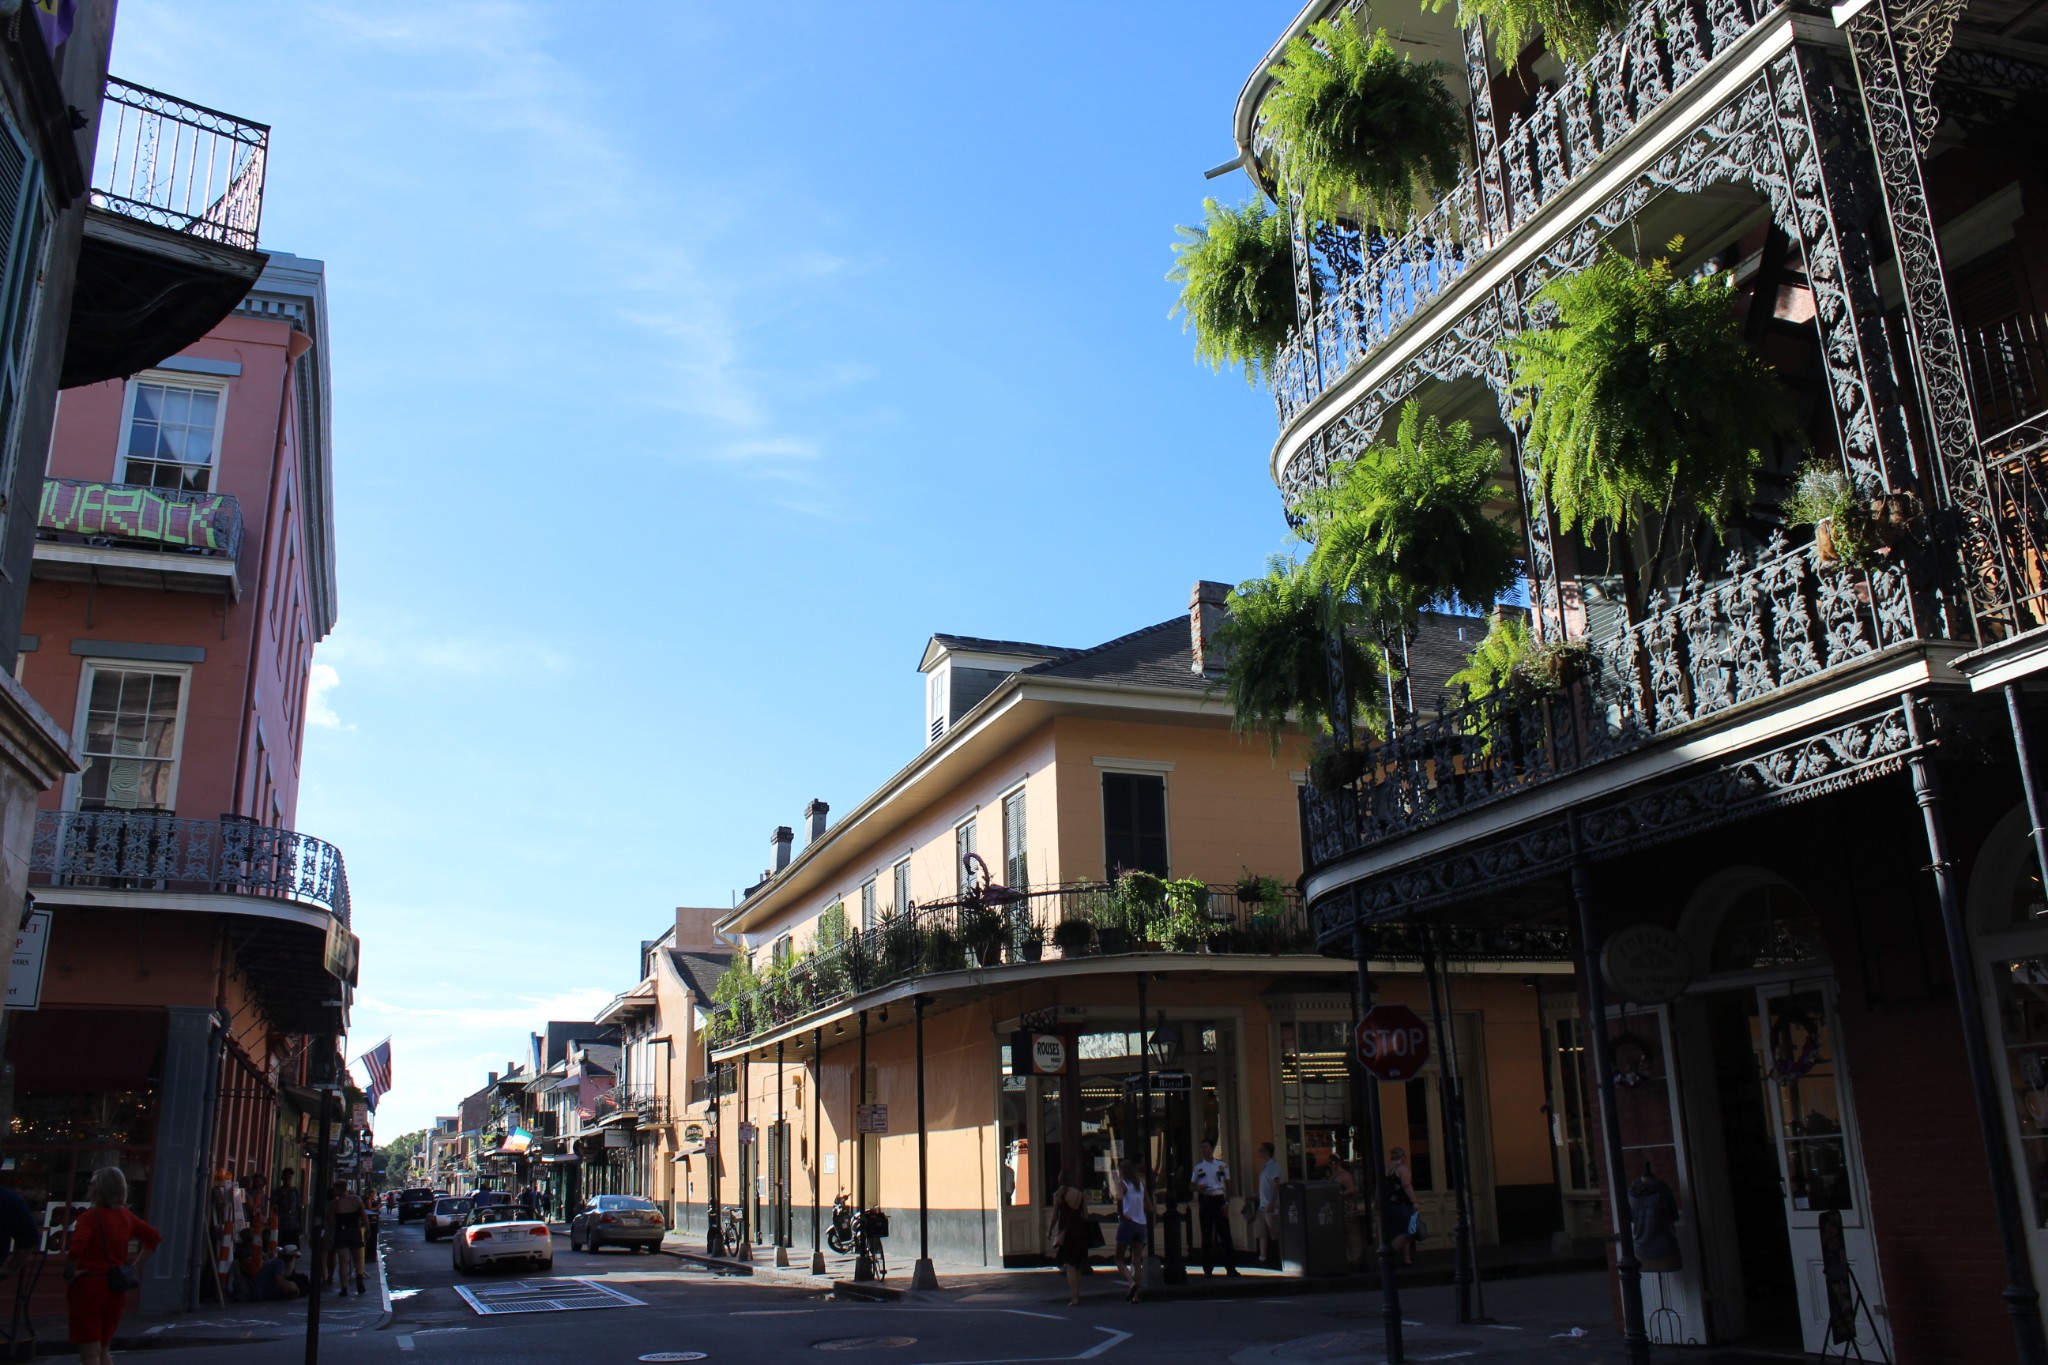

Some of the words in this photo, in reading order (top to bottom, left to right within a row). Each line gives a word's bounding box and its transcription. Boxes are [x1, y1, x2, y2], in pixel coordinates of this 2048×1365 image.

[1037, 1042, 1060, 1056] ROUSES
[1362, 1028, 1424, 1058] STOP
[1159, 1079, 1184, 1088] Royal
